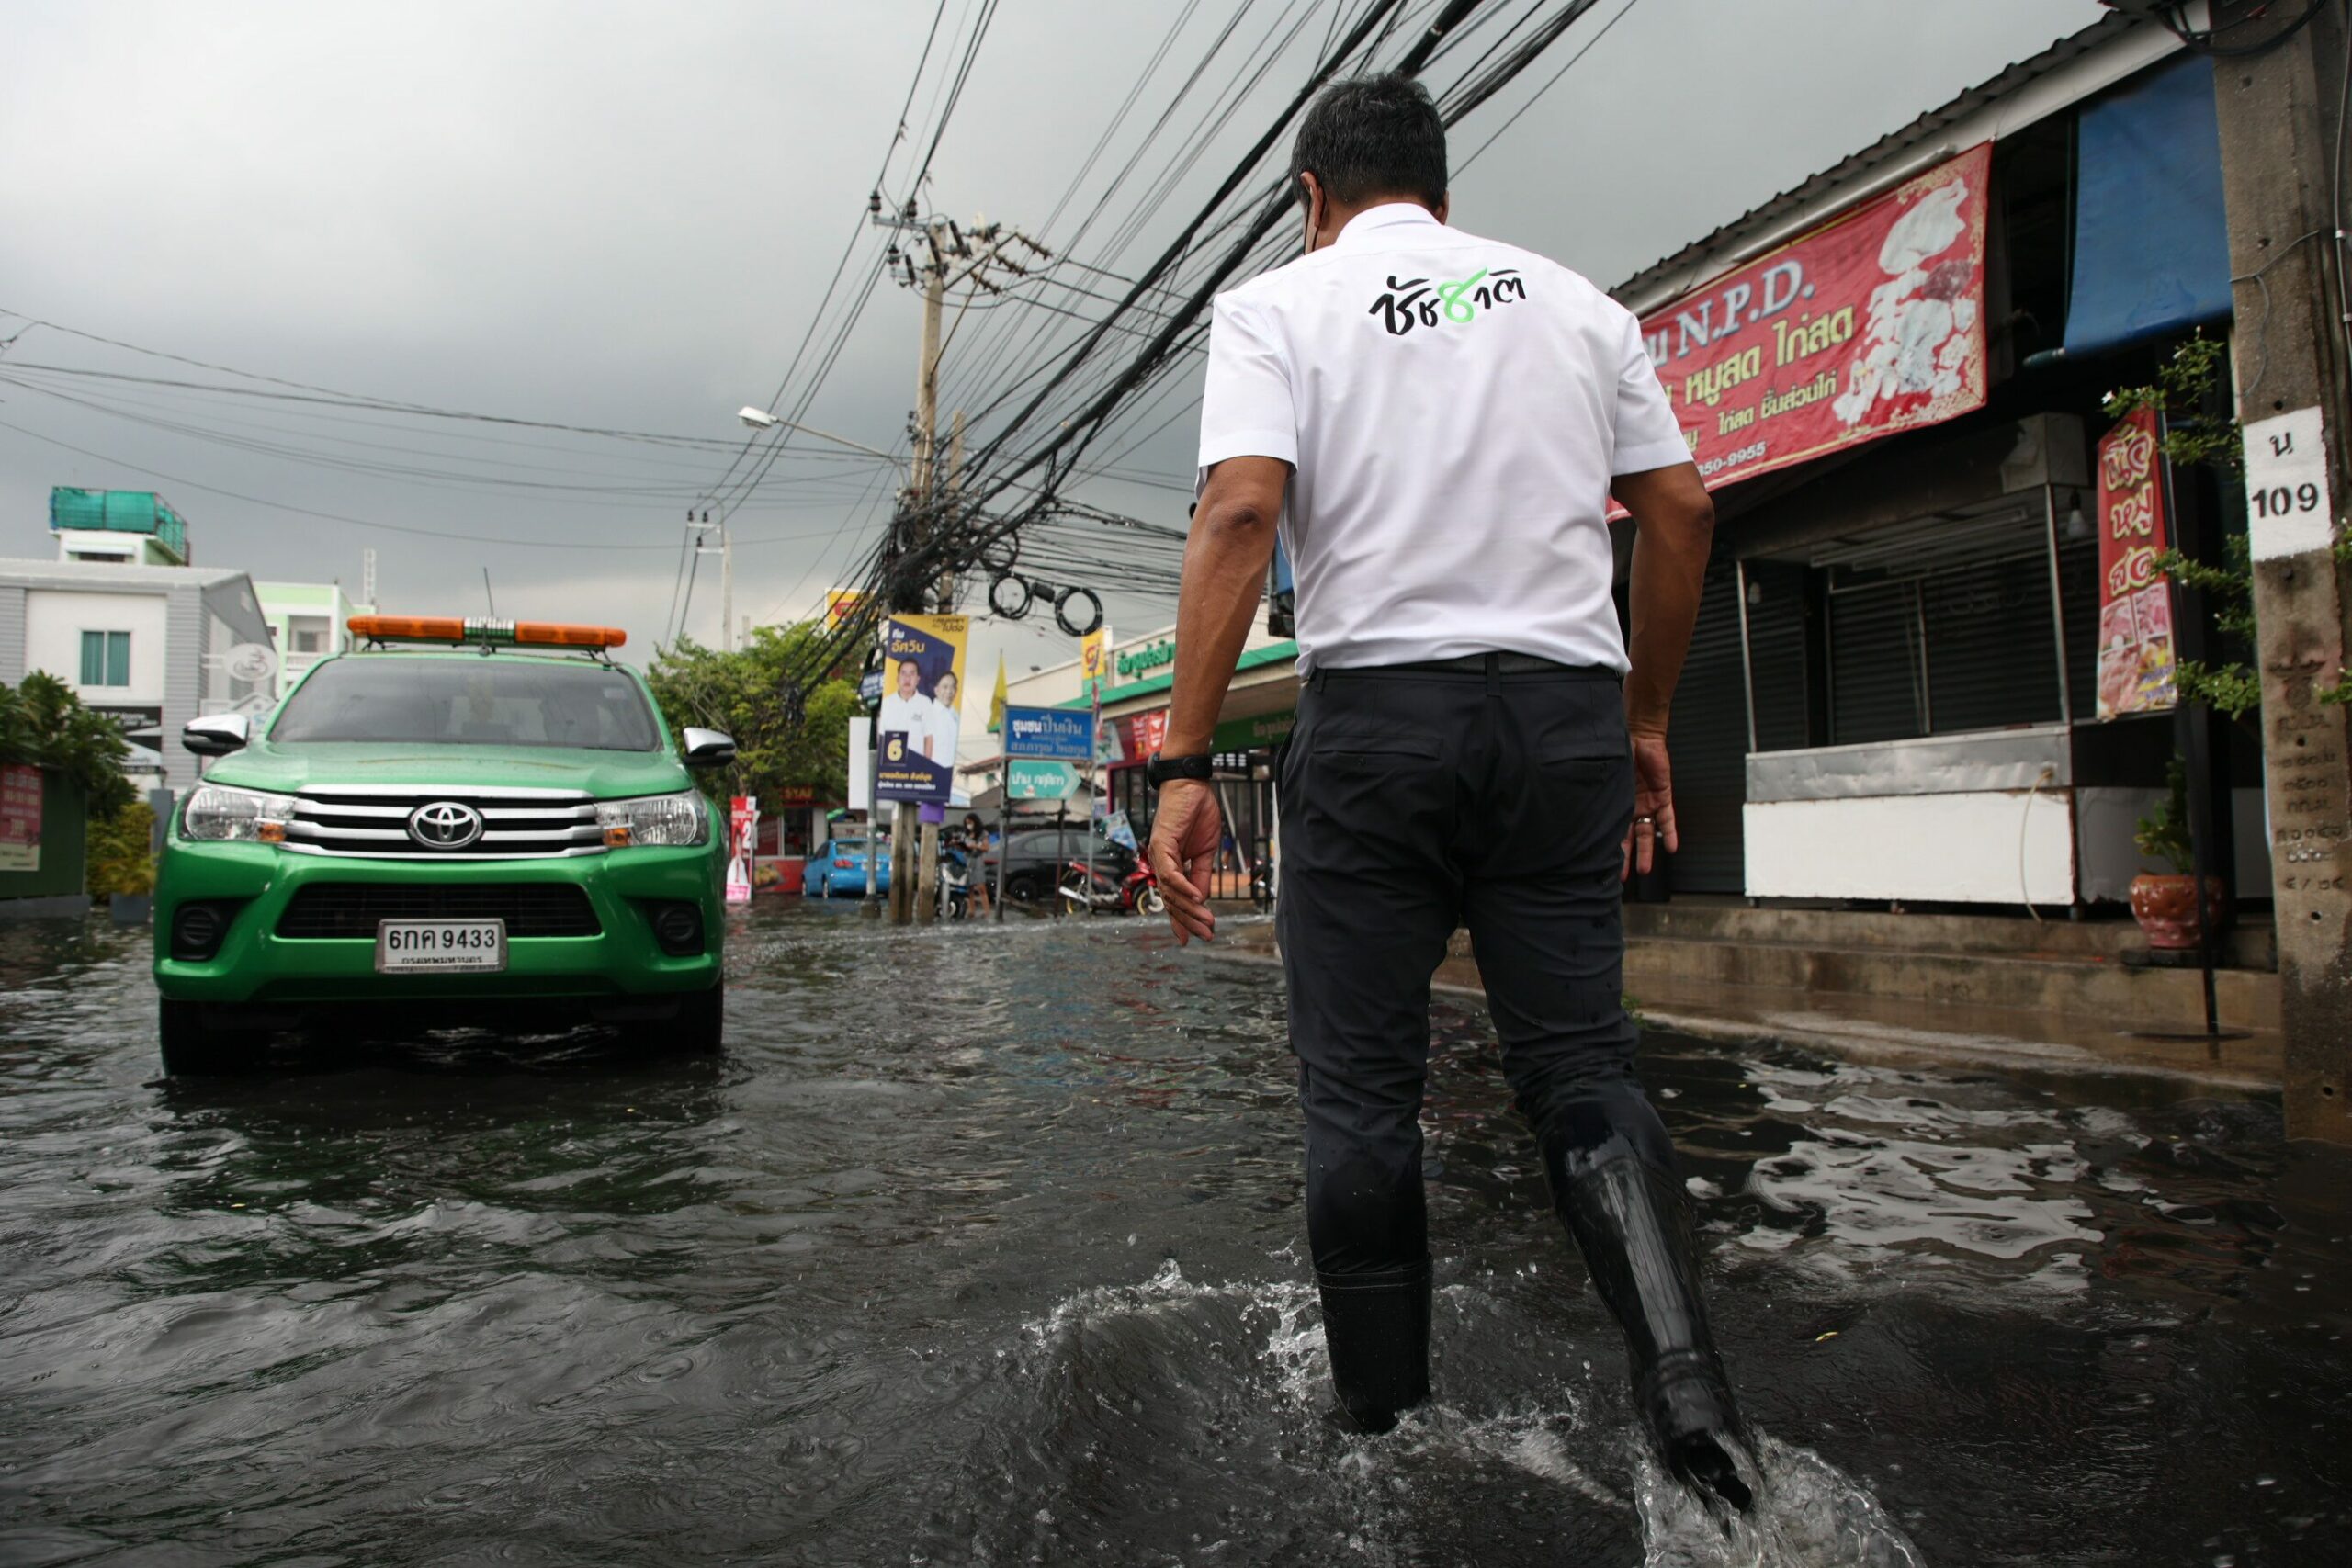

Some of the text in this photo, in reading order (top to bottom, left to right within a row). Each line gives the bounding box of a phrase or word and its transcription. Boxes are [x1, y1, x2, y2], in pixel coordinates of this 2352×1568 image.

[1369, 266, 1526, 335] ชัชชาติ
[1676, 260, 1815, 359] N.P.D.
[1684, 345, 1761, 407] หมูสด
[1772, 305, 1855, 368] ไก่สด
[1718, 406, 1755, 436] ไก่สด
[2110, 480, 2154, 540] หมู
[2252, 482, 2320, 519] 109
[2109, 546, 2157, 596] สด
[891, 639, 925, 653] อัศวิน
[888, 739, 902, 761] 6
[389, 929, 496, 949] 6กค 9433
